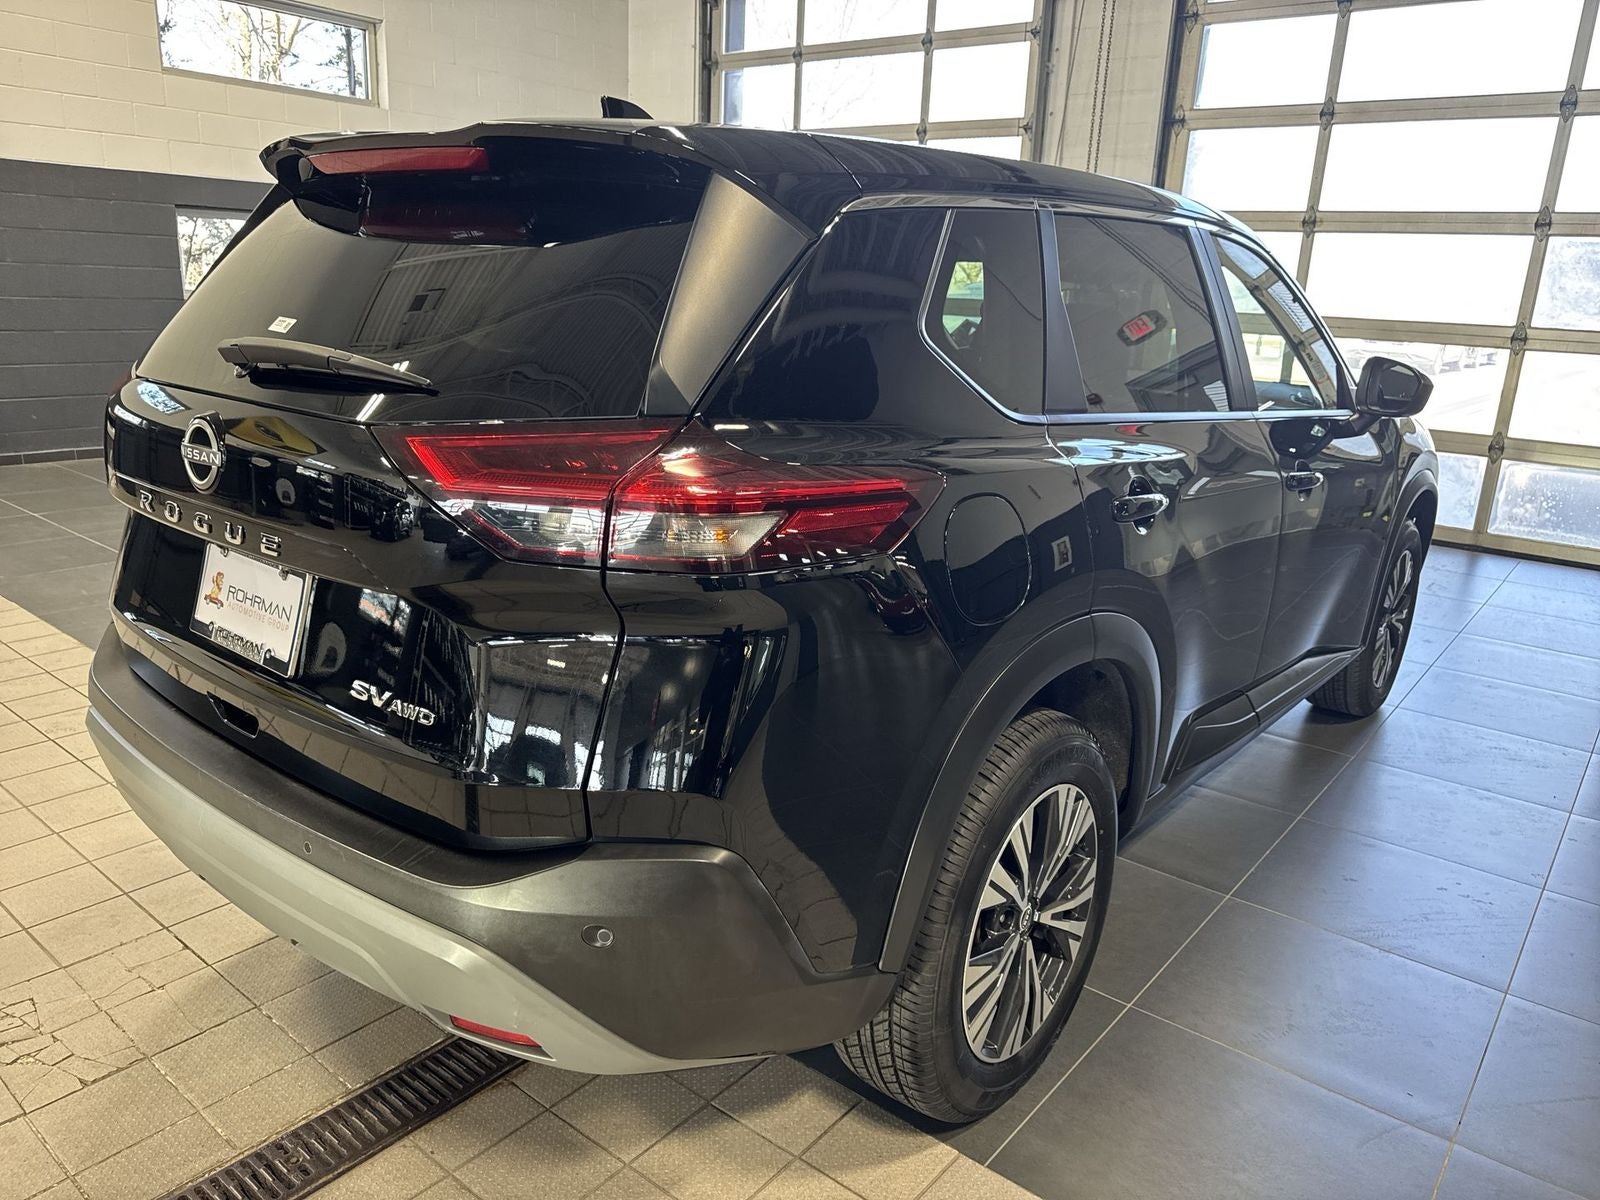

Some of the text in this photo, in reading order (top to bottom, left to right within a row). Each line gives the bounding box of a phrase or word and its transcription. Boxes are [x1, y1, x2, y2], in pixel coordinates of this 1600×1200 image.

[140, 490, 281, 557] ROGUE
[227, 585, 292, 622] ROHRMAN
[227, 602, 290, 632] AUTOMOTIVE GROUP
[216, 625, 264, 655] ROHRMAN
[350, 680, 436, 726] SV AWD
